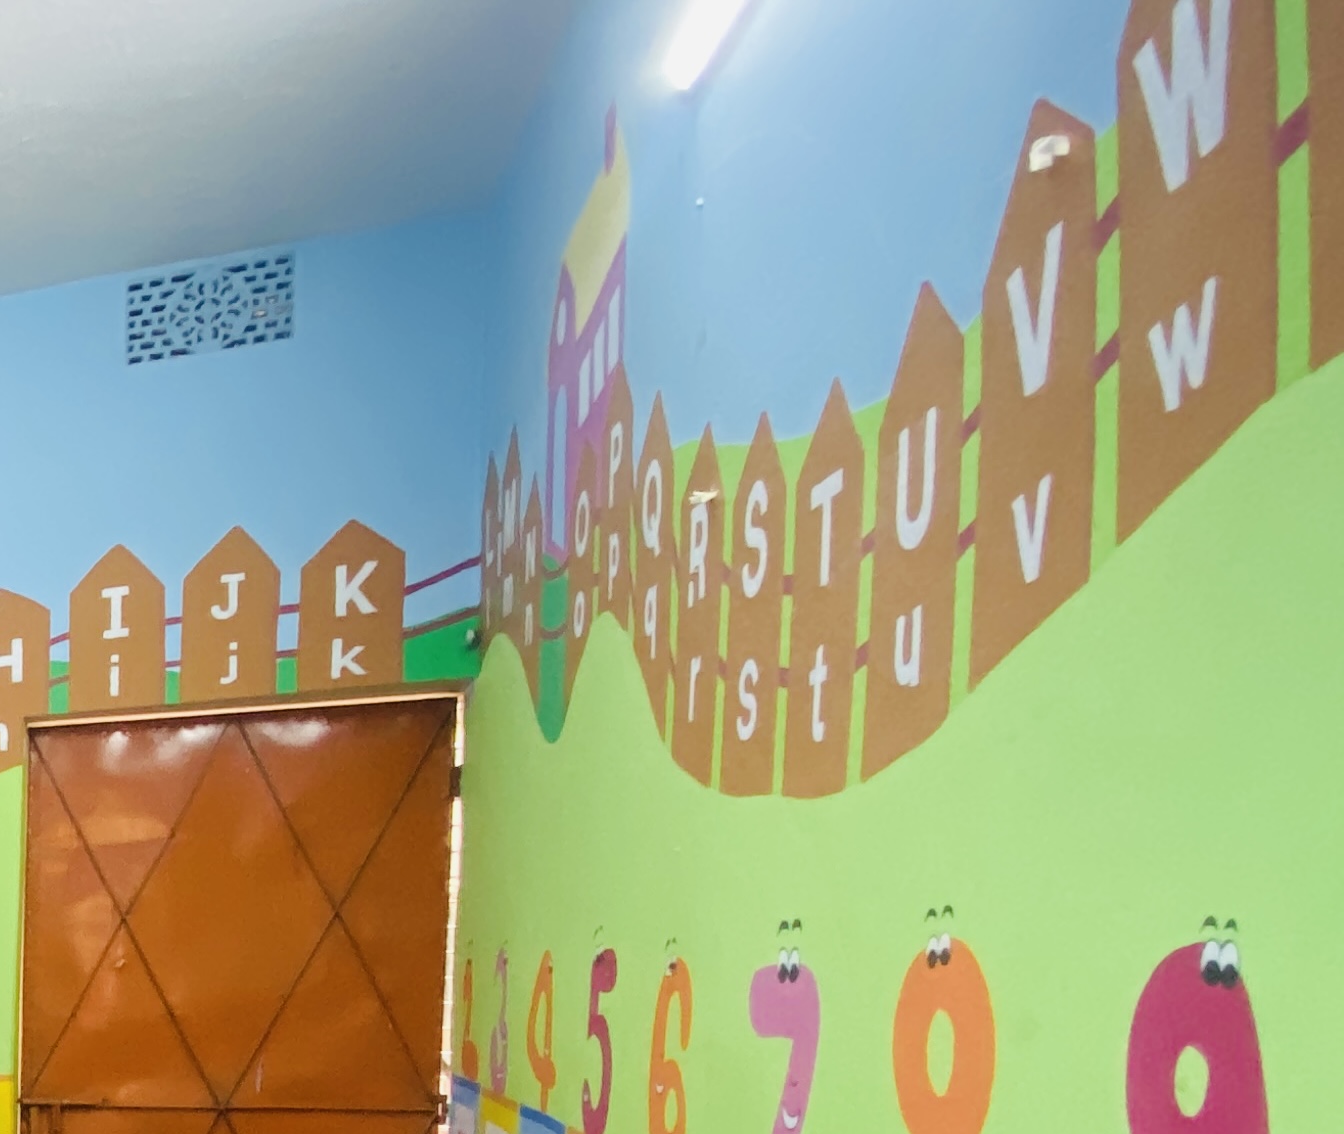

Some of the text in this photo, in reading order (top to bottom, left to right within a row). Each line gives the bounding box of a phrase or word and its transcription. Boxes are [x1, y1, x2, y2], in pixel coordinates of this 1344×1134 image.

[574, 491, 589, 557] O
[609, 421, 624, 506] P
[642, 458, 662, 556] Q
[742, 480, 768, 597] S
[811, 469, 843, 585] T
[896, 407, 937, 549] U
[1006, 221, 1063, 396] V
[1132, 0, 1231, 192] W
[574, 591, 585, 637] o
[608, 533, 620, 599] p
[645, 585, 657, 658] q
[689, 656, 701, 721] r
[737, 659, 758, 740] s
[809, 645, 827, 742] t
[895, 605, 922, 686] u
[1012, 475, 1051, 583] v
[1148, 277, 1217, 411] w
[102, 586, 129, 639] I
[211, 573, 245, 619] J
[335, 561, 377, 616] K
[110, 655, 119, 696] i
[220, 642, 237, 684] j
[331, 638, 366, 679] k
[527, 950, 556, 1114] 4
